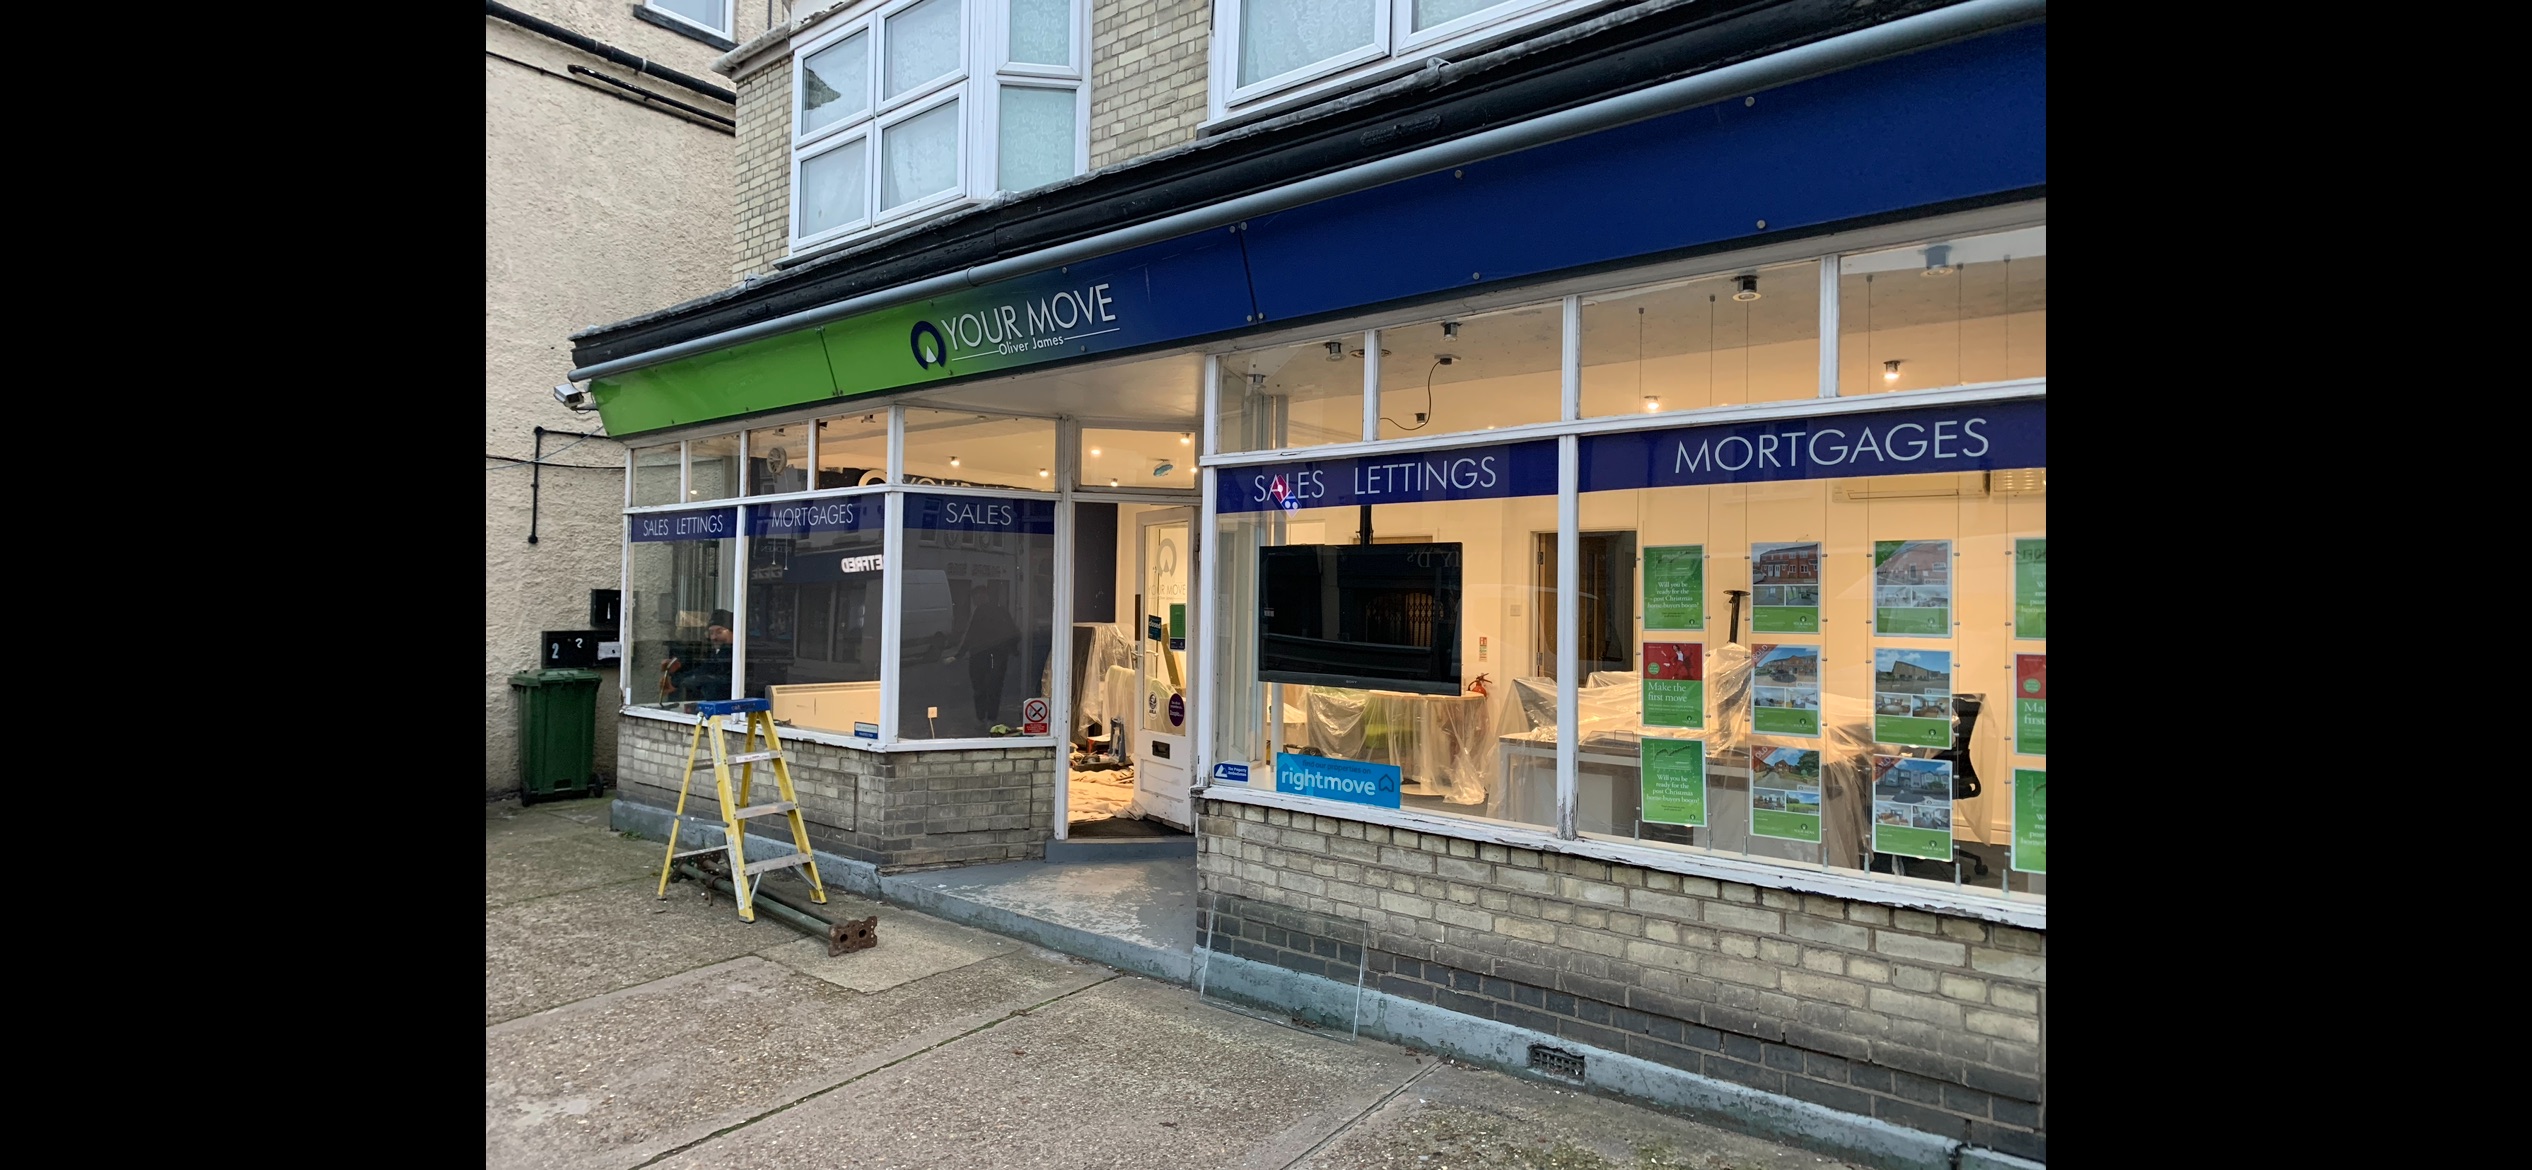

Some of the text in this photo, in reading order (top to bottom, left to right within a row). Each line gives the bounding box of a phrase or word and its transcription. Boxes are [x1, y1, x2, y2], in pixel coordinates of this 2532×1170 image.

[941, 283, 1116, 350] YOUR MOVE
[999, 335, 1064, 355] Oliver James
[1675, 418, 1990, 474] MORTGAGES
[1253, 456, 1497, 503] SALES LETTINGS
[771, 503, 854, 528] MORTGAGES
[945, 502, 1012, 526] SALES
[643, 514, 724, 537] SALES LETTINGS
[1167, 584, 1187, 596] MOVE
[551, 642, 559, 659] 2
[1647, 681, 1687, 692] Make the
[1647, 692, 1688, 703] first move
[1302, 760, 1315, 768] find
[1327, 763, 1361, 773] properties
[1281, 767, 1376, 796] rightmove
[1665, 788, 1693, 796] Christmas
